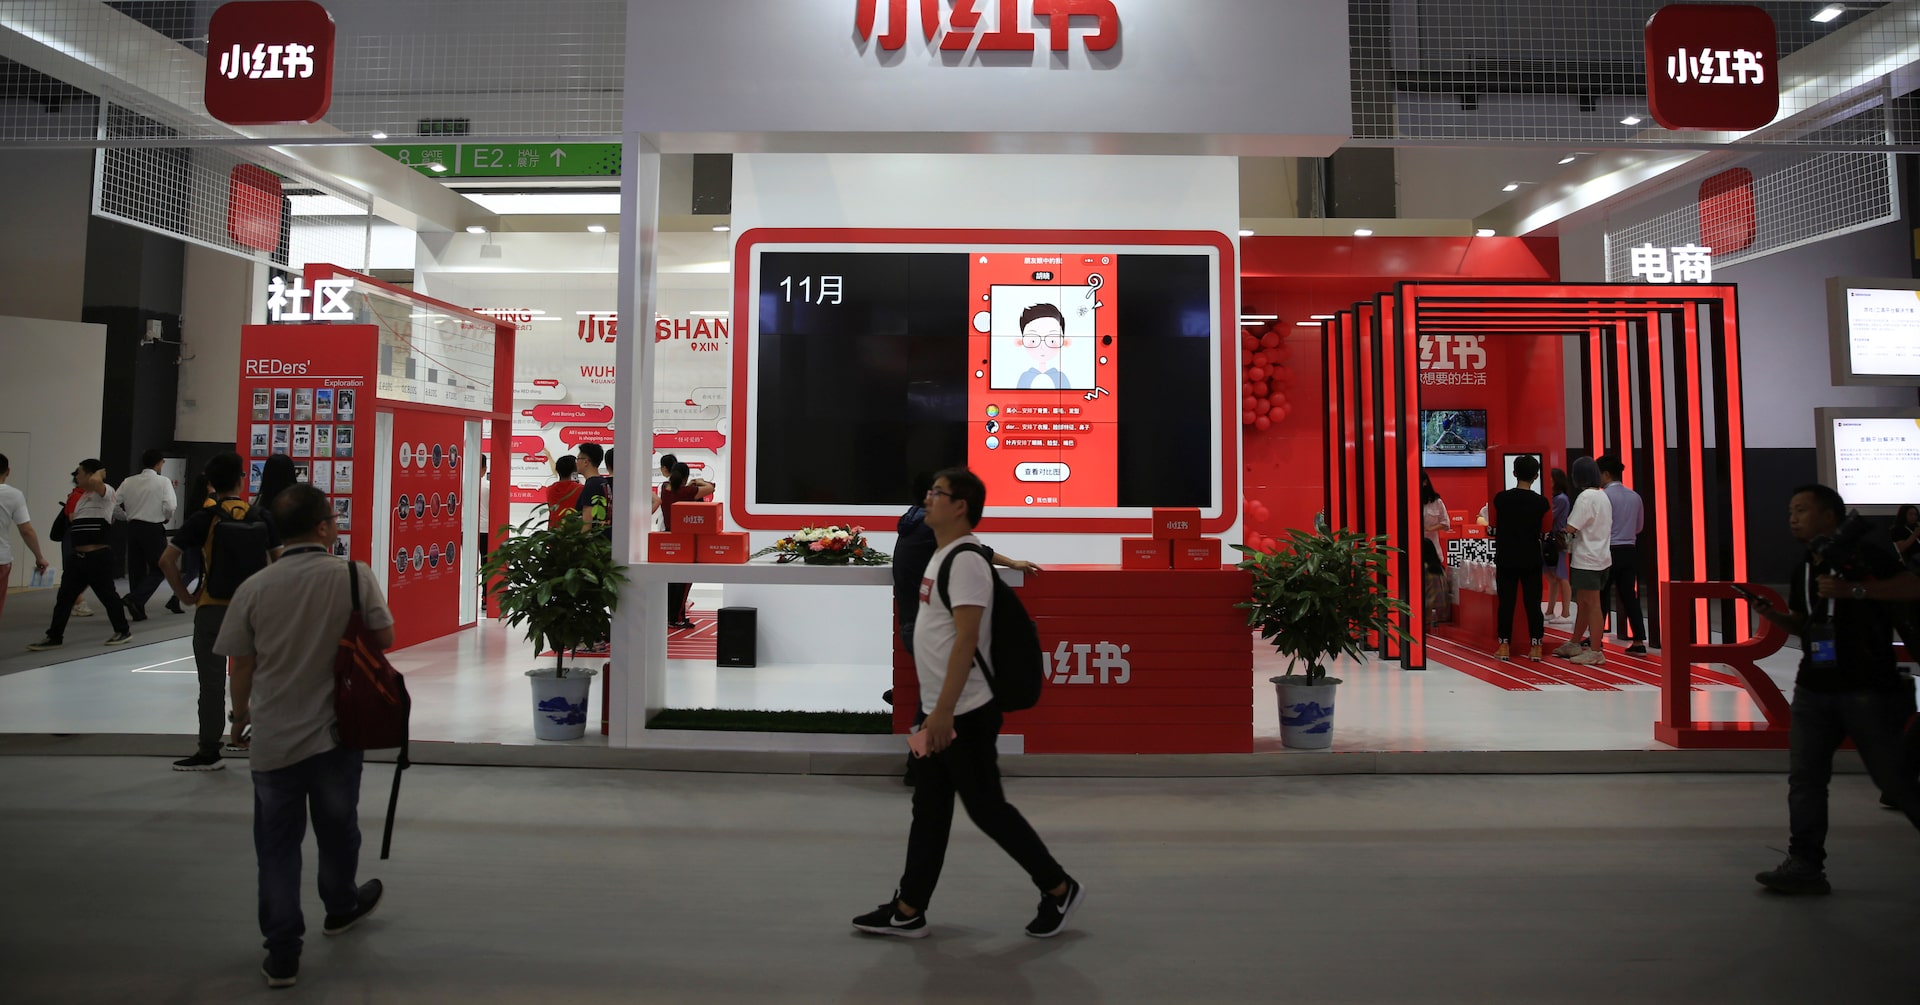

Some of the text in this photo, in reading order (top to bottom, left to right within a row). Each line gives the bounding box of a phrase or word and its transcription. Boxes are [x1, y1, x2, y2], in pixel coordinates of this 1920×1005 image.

[219, 43, 315, 80] 小红书
[1667, 47, 1765, 84] 小红书
[517, 157, 540, 168] 展厅
[1630, 242, 1712, 283] 电商
[779, 276, 844, 305] 11月
[267, 276, 354, 322] 社区
[699, 342, 719, 352] XIN
[245, 359, 311, 375] REDers'
[580, 366, 615, 378] WUH
[324, 379, 364, 389] Exploration
[1024, 468, 1061, 476] 查看对比图
[1166, 521, 1189, 530] 小红书
